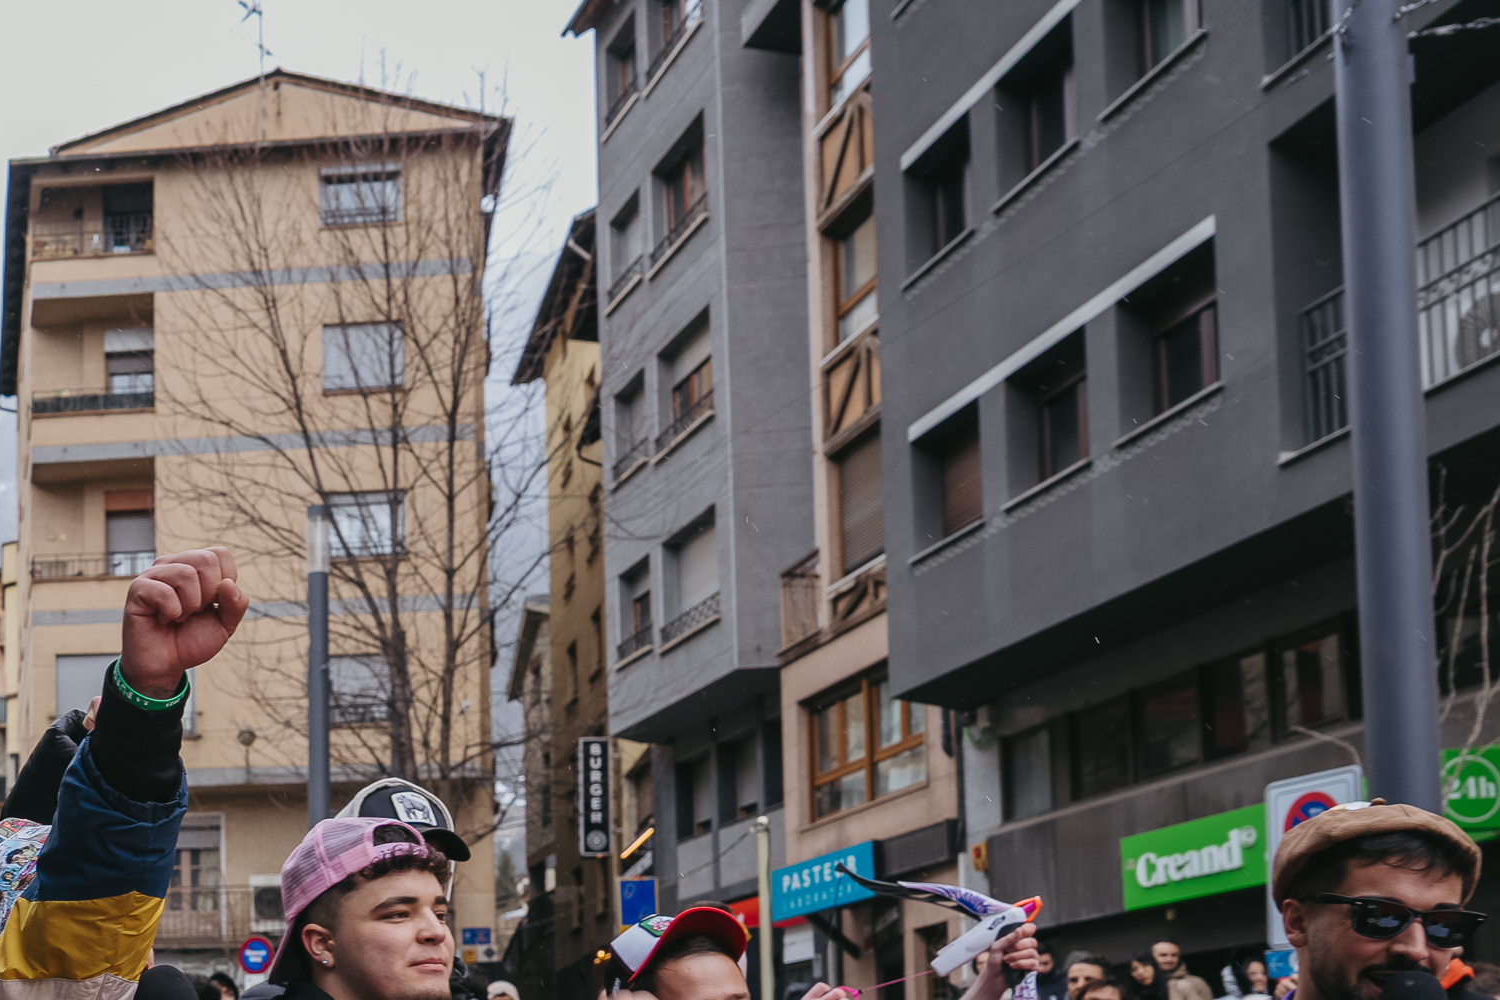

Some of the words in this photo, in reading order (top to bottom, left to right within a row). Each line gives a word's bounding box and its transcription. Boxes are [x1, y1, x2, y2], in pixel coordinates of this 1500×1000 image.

[589, 743, 603, 824] BURGER
[1446, 776, 1496, 799] 24h
[1136, 828, 1243, 888] Creand
